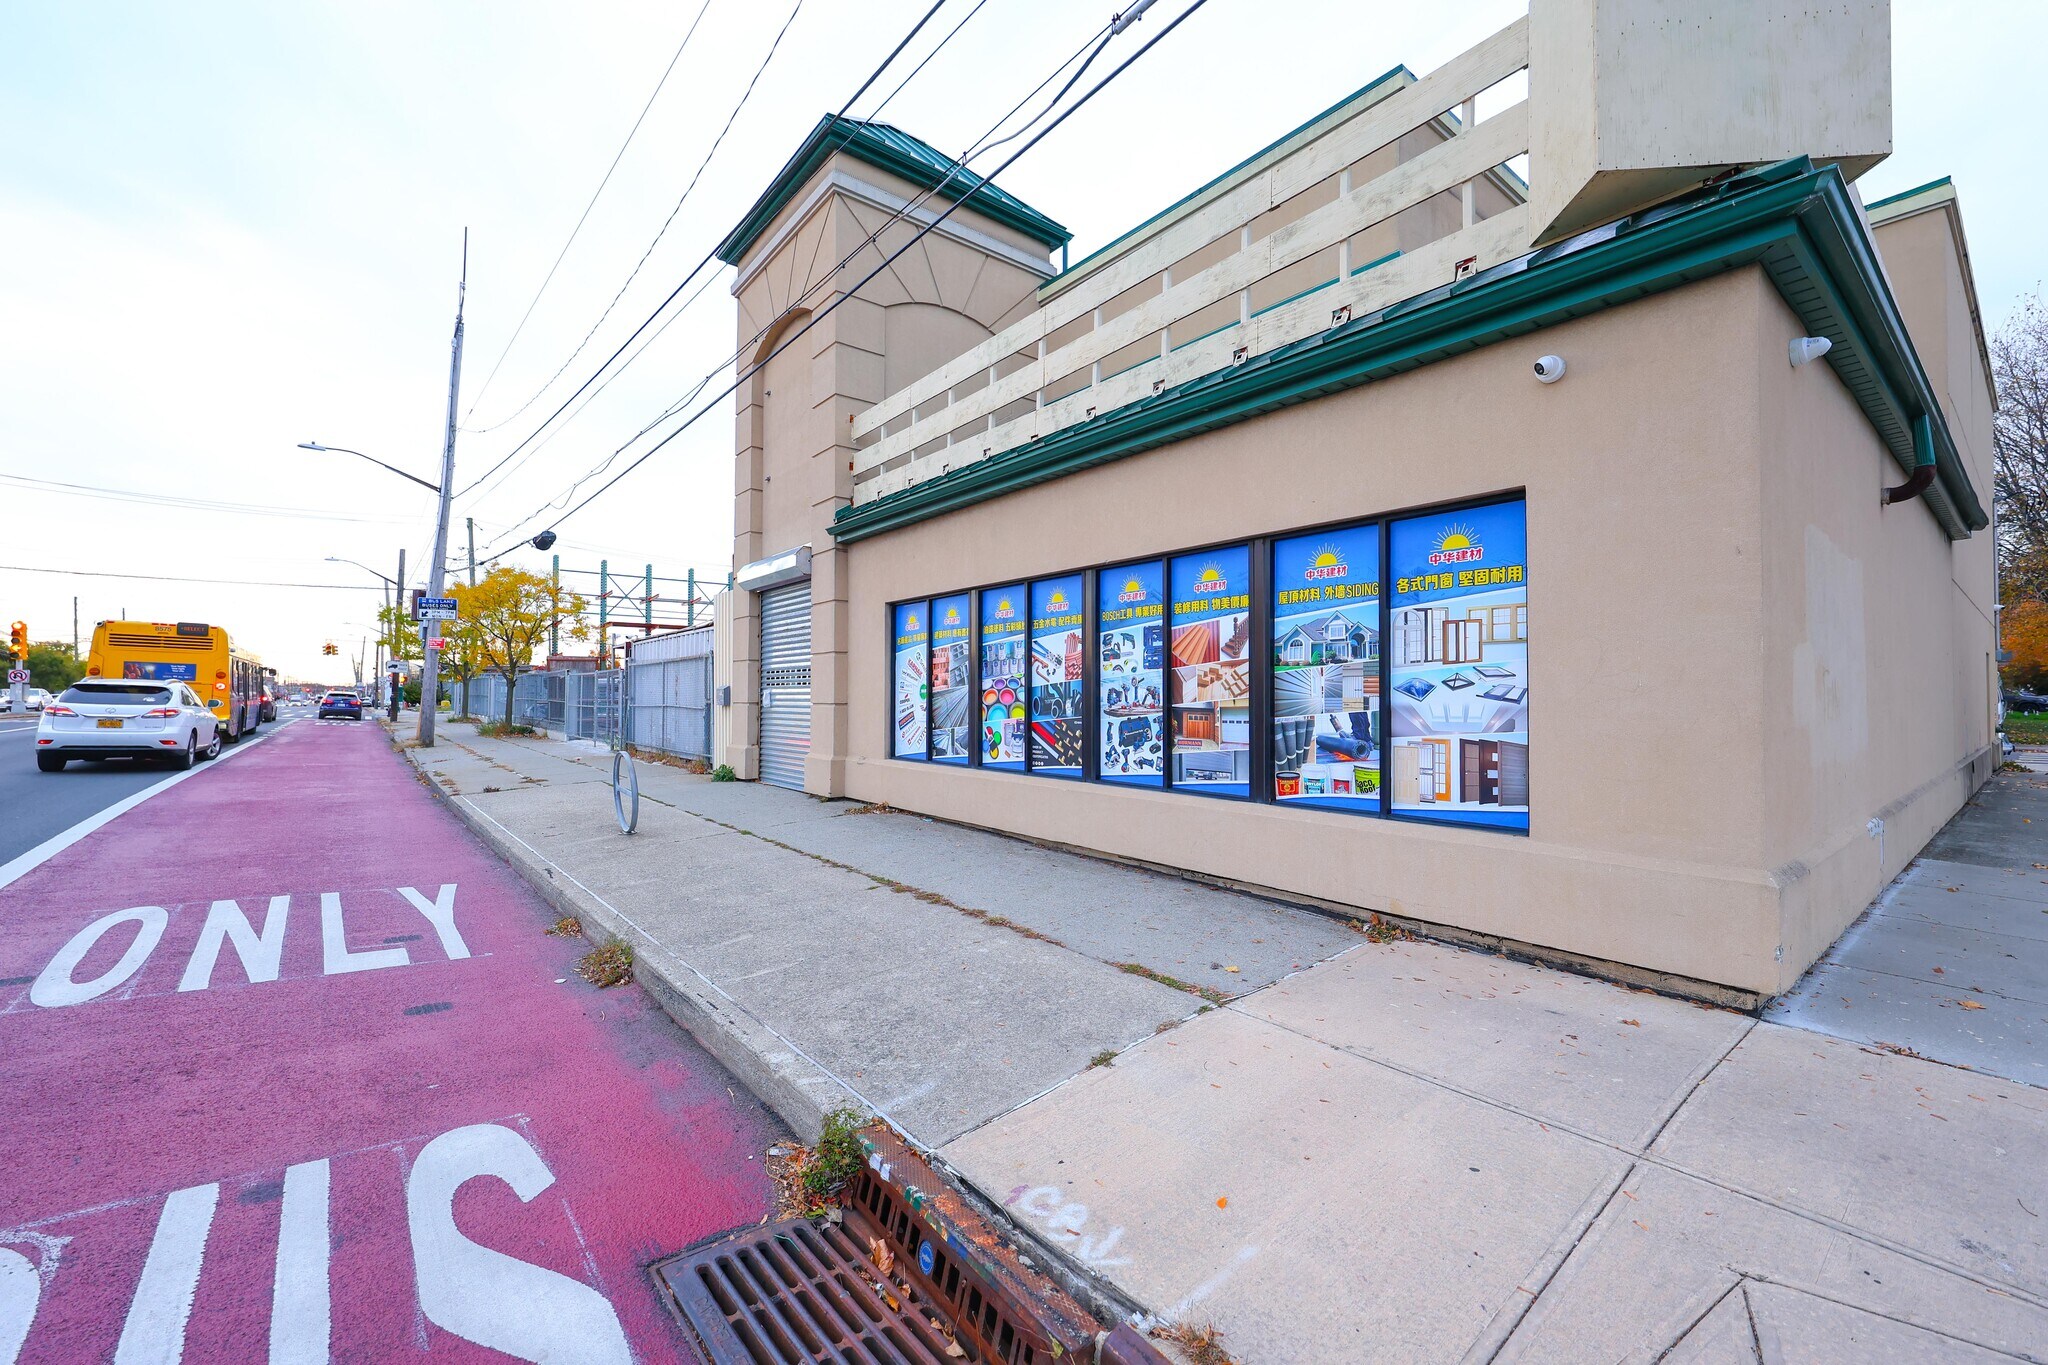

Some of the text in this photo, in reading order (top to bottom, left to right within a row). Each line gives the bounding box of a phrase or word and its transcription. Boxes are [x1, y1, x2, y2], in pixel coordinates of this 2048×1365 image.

[1429, 548, 1483, 565] 中华建材
[1305, 565, 1348, 580] 中华建材
[1396, 566, 1523, 594] 各式門窗 堅固耐用
[1194, 580, 1227, 593] 中华建材
[1118, 591, 1147, 602] 中华建材
[1279, 587, 1320, 605] 屋頂材料
[30, 884, 471, 1007] ONLY
[0, 1123, 634, 1365] US
